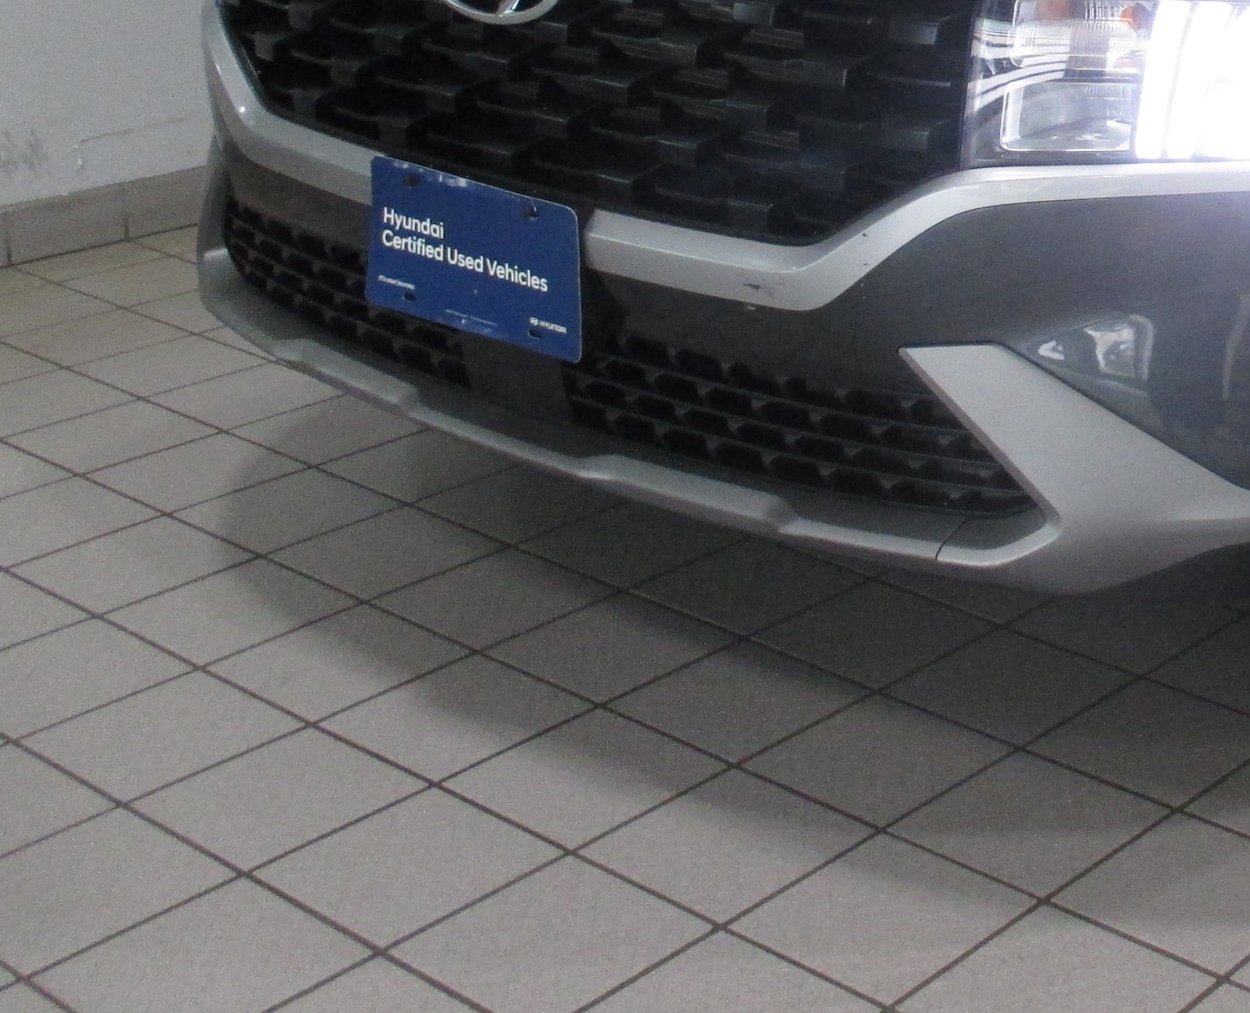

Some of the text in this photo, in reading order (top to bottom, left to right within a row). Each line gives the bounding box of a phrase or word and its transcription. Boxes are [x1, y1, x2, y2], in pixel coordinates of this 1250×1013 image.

[384, 207, 444, 239] Hyundai
[382, 230, 548, 292] Certified Used Vehicles
